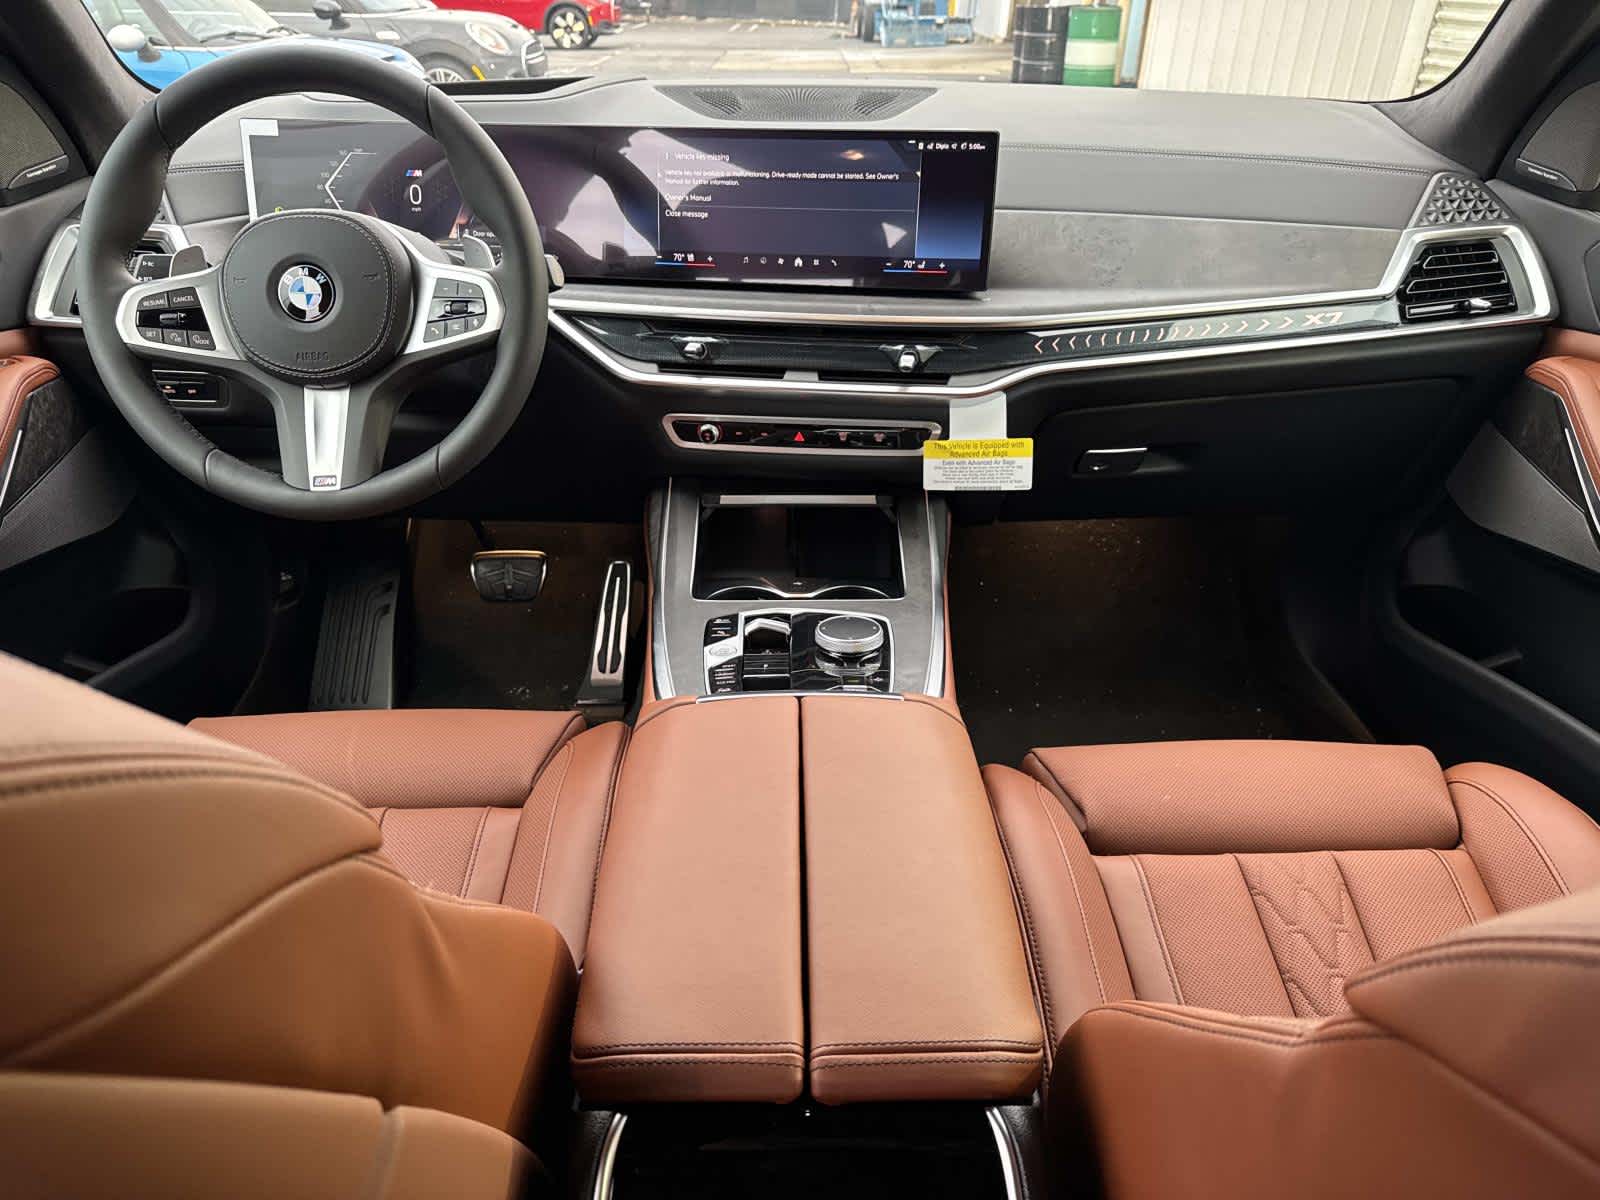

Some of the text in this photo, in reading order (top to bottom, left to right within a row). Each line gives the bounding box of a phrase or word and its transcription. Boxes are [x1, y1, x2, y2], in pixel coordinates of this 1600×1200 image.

[707, 153, 730, 162] missing
[771, 171, 801, 180] Drive-ready
[802, 172, 817, 180] mode
[818, 172, 836, 180] cannot
[836, 172, 844, 180] be
[865, 172, 876, 180] See
[877, 172, 900, 180] Owner's
[409, 184, 422, 205] 0
[664, 193, 712, 202] Owner's Manual
[665, 209, 709, 220] Close message
[283, 266, 328, 286] BMW
[173, 295, 194, 303] CANCEL
[1300, 311, 1344, 328] X7
[295, 350, 330, 361] AIRBAG
[933, 442, 947, 450] This
[1011, 441, 1025, 449] with
